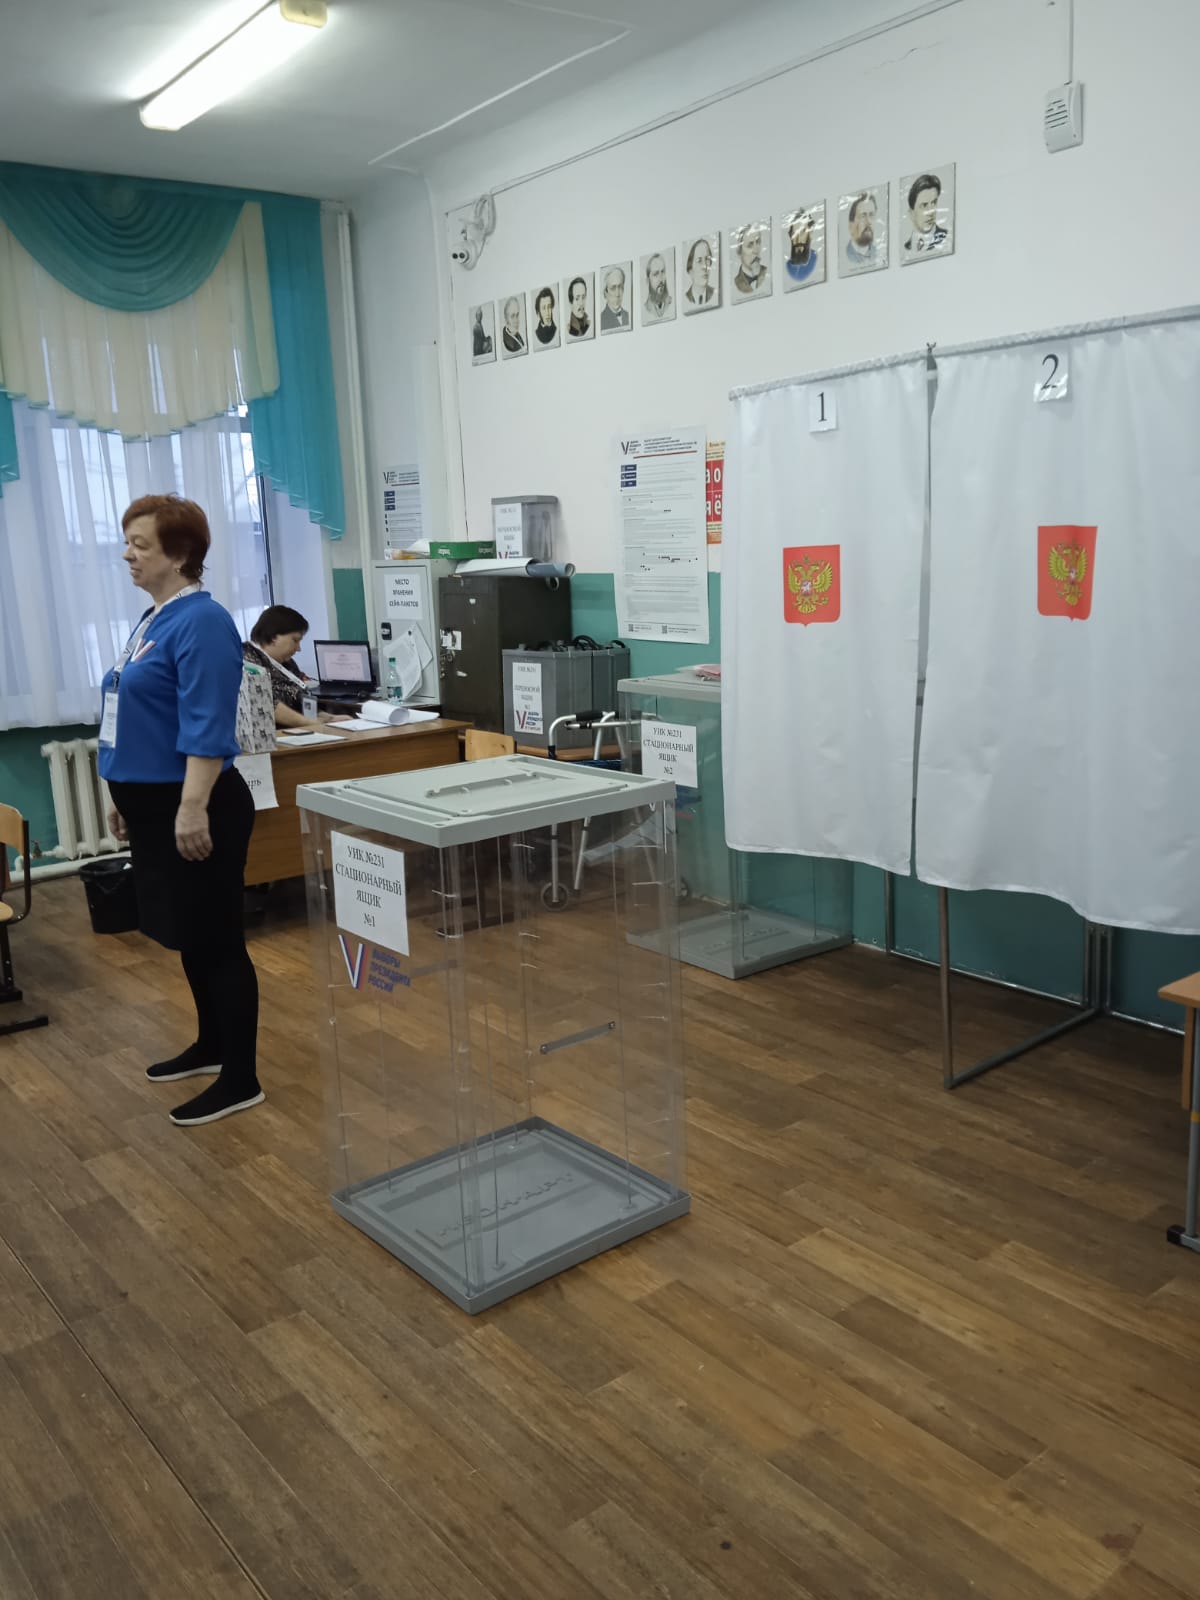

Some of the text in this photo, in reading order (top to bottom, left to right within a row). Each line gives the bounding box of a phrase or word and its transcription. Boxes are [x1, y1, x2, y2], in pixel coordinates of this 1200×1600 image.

[1040, 353, 1059, 391] 2
[817, 391, 828, 422] 1
[643, 739, 694, 753] СТАЦИОНАРНЫЙ
[658, 753, 677, 762] ЯЩИК
[347, 845, 385, 869] УИК №231
[335, 863, 402, 896] СТАЦИОНАРНЫЙ
[356, 889, 382, 909] ЯЩИК
[363, 912, 376, 928] №1
